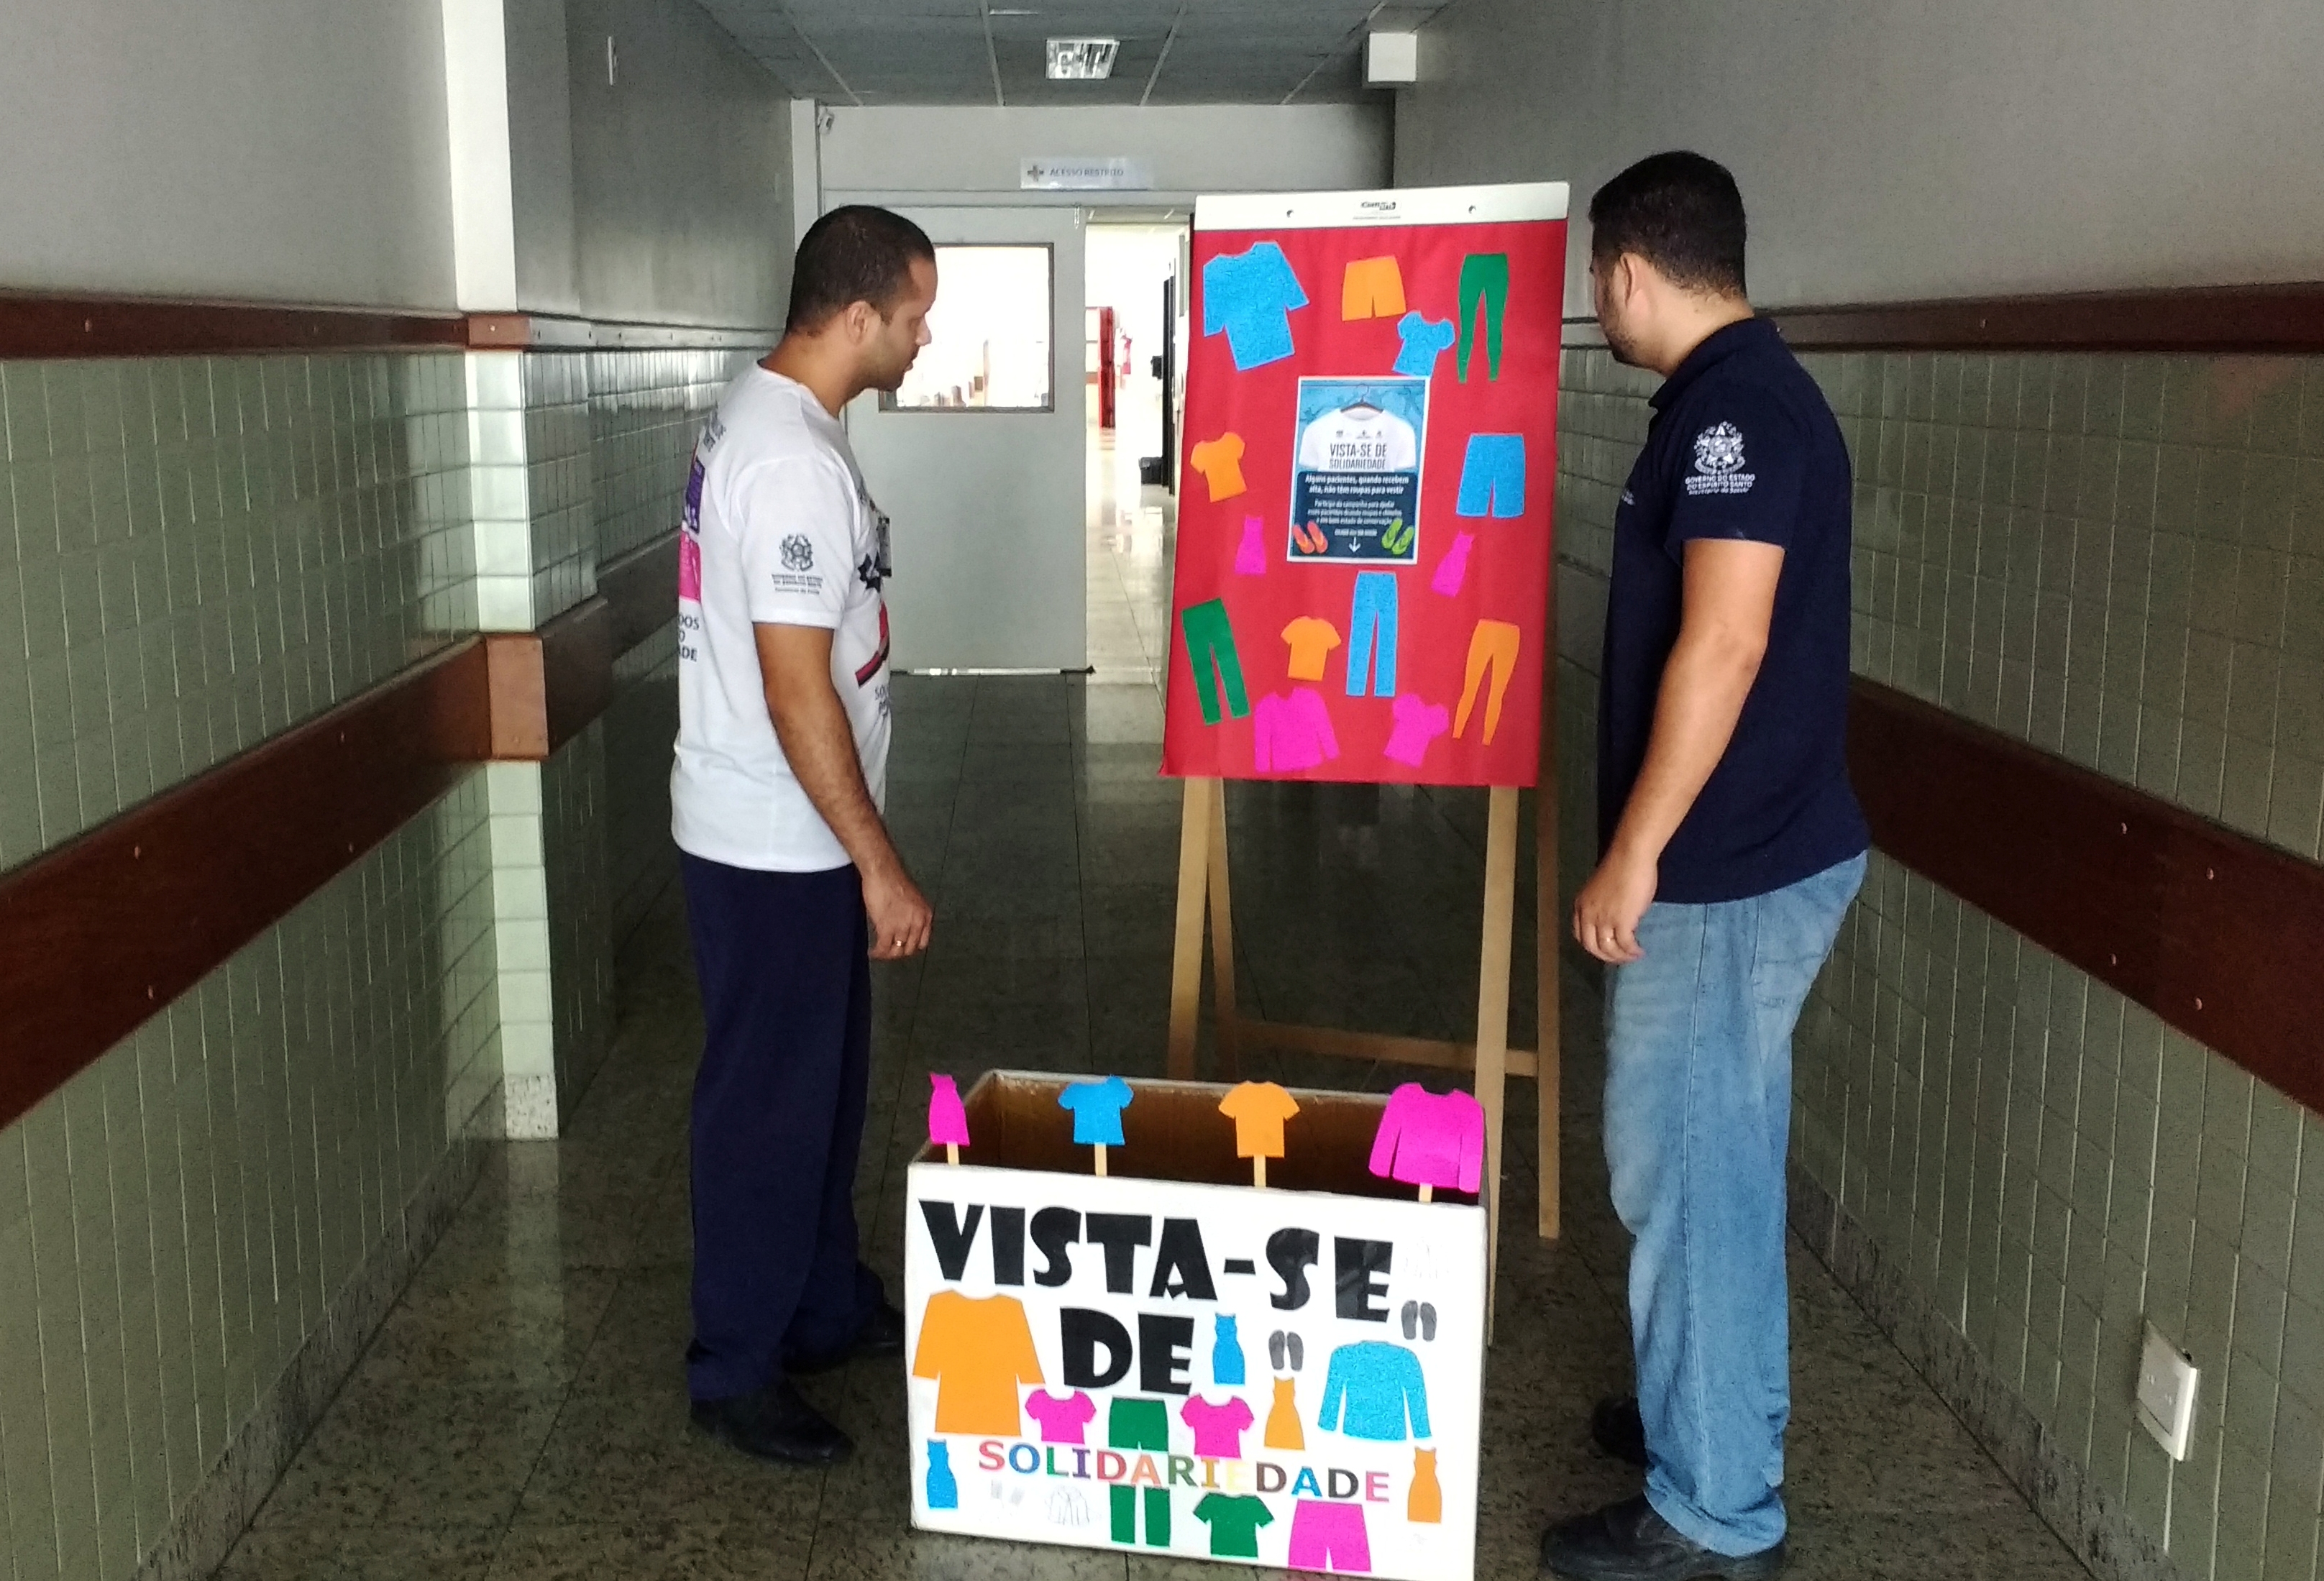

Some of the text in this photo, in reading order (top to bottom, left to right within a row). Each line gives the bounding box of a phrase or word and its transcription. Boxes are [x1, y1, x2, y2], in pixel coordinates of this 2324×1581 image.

[1329, 458, 1386, 469] SOLIDARIEDADE
[1330, 443, 1387, 457] VISTA-SE DE
[918, 1198, 1394, 1323] VISTA-SE
[1059, 1306, 1194, 1396] DE
[979, 1441, 1390, 1503] SOLIDARIEDADE
